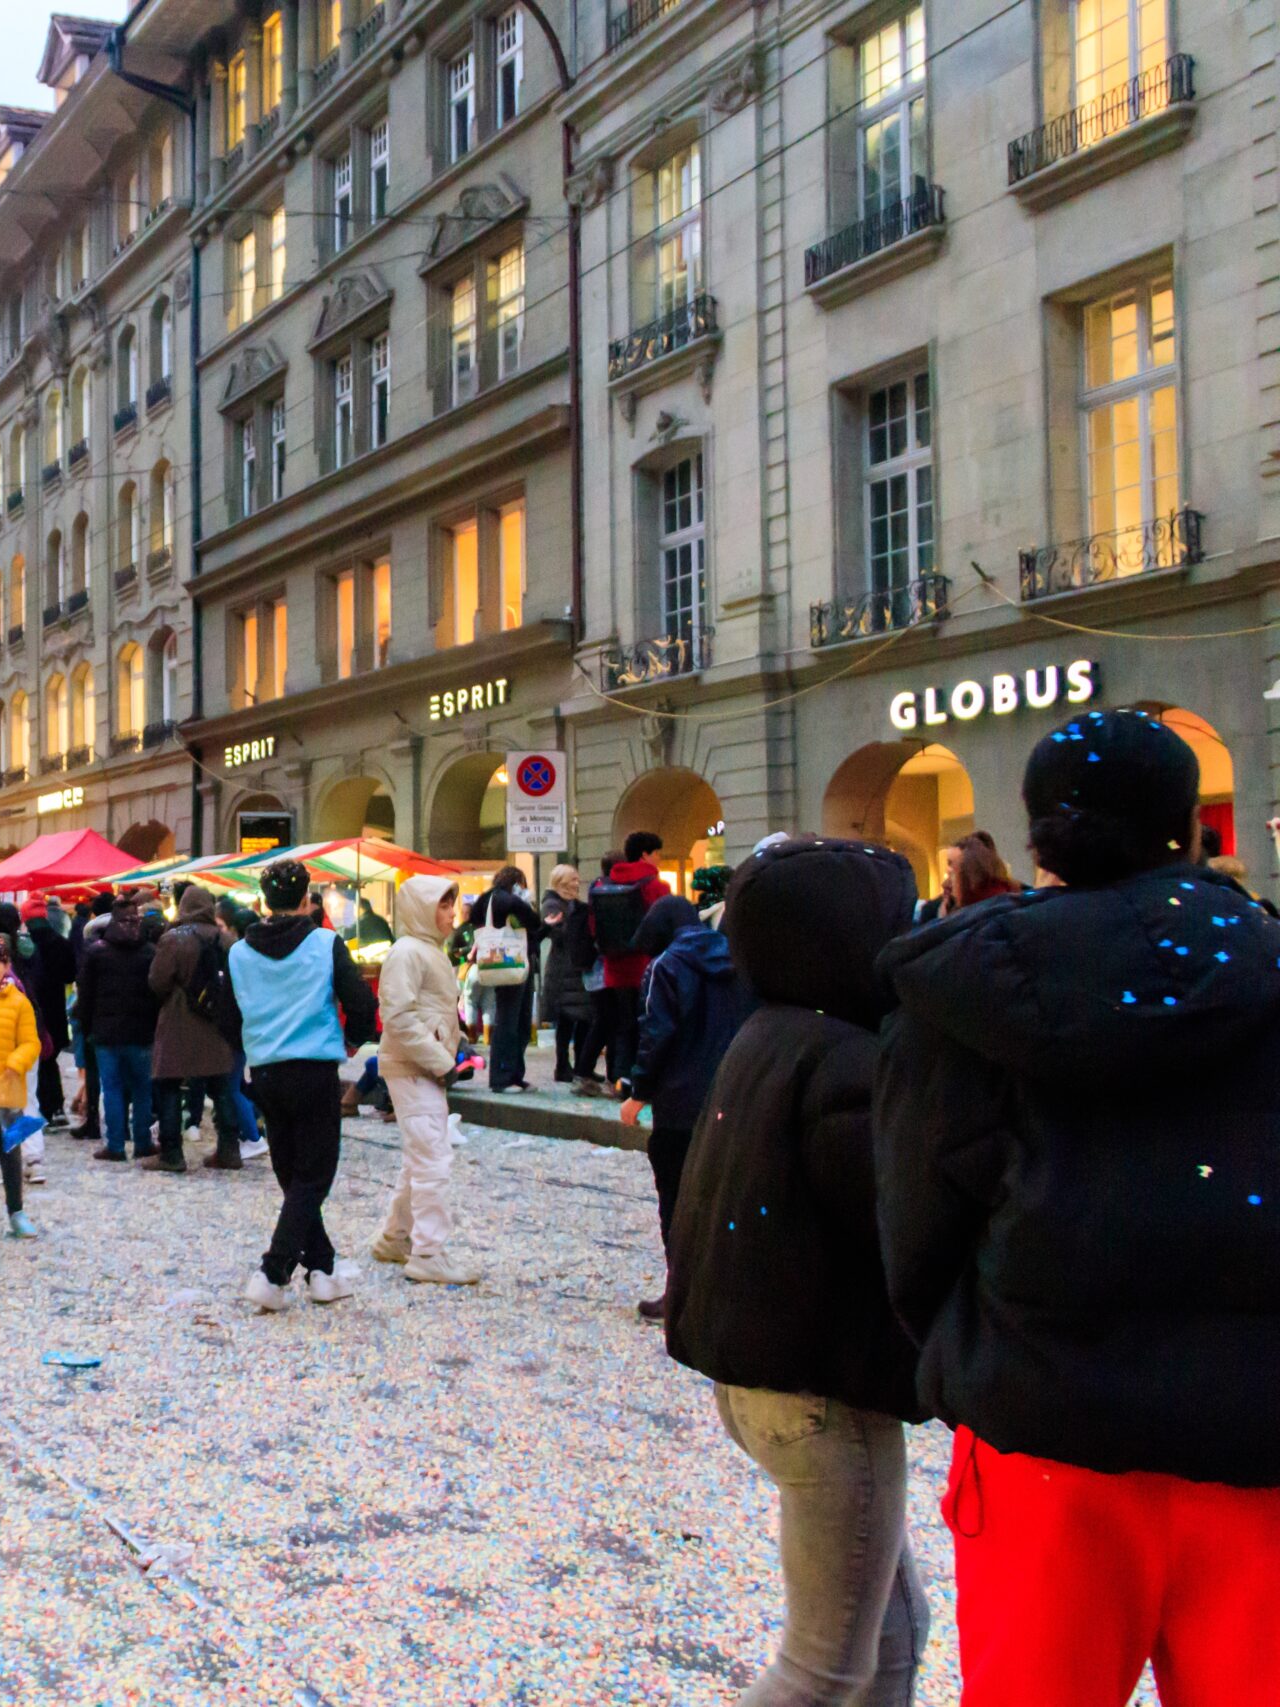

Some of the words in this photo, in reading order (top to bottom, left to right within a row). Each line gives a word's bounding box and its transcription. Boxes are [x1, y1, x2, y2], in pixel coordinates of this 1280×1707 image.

[430, 679, 507, 720] ESPRIT
[890, 660, 1093, 729] GLOBUS
[225, 737, 274, 768] ESPRIT
[529, 815, 554, 823] Montag
